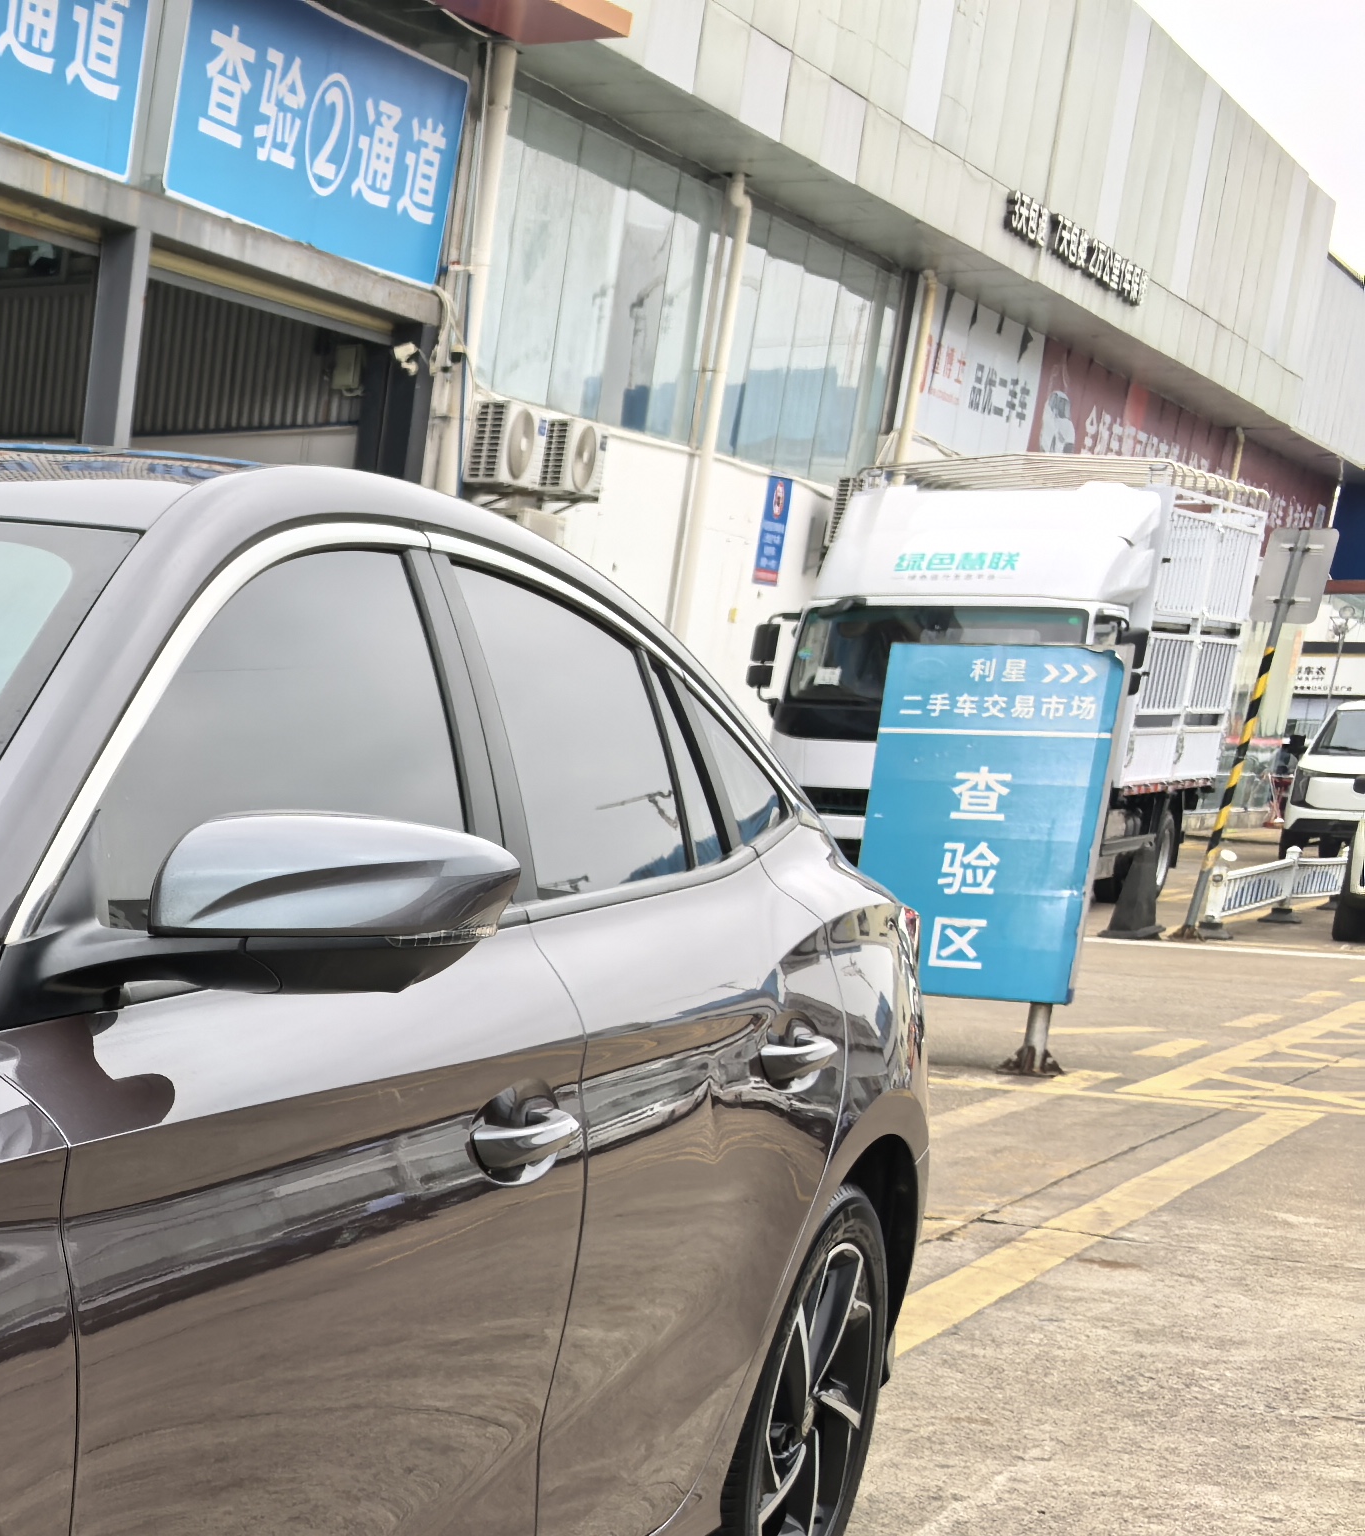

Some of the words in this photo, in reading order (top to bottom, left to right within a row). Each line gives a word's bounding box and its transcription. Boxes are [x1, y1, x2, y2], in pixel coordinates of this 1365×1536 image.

[198, 24, 446, 225] 查验②通道
[970, 658, 1027, 682] 利星
[899, 693, 1097, 720] 二手车交易市场
